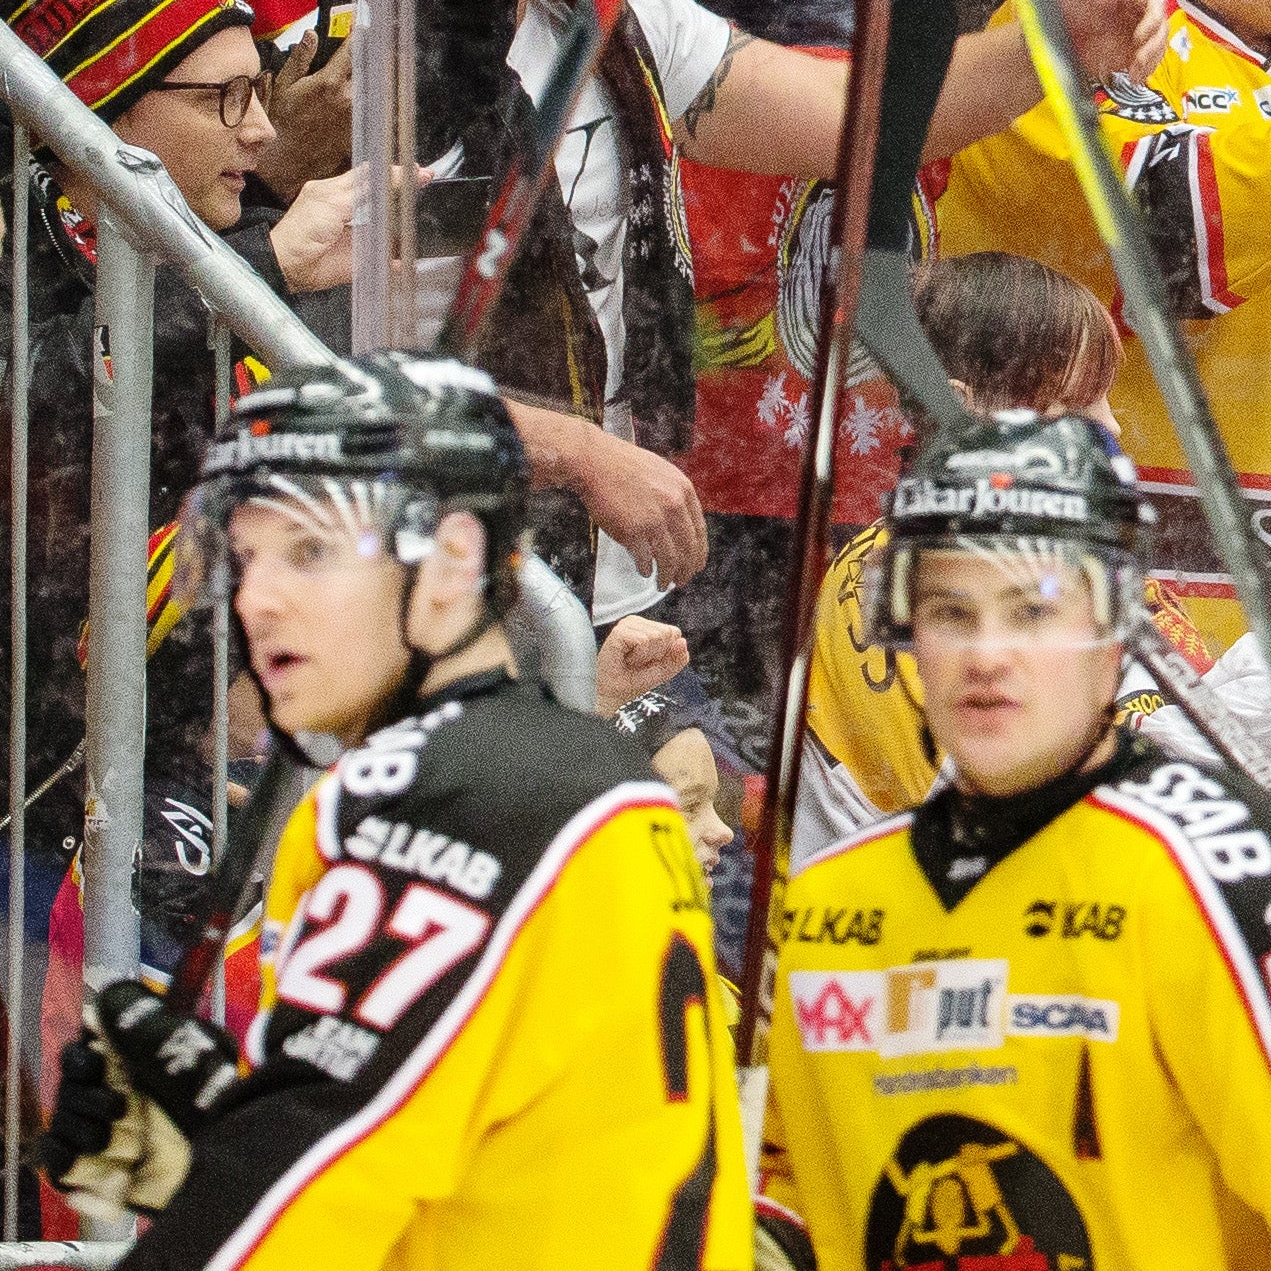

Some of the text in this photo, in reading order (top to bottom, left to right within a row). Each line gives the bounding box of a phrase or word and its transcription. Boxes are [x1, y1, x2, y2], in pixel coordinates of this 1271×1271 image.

[385, 821, 501, 900] LKAB
[277, 860, 493, 1033] 27
[796, 907, 886, 946] LKAB
